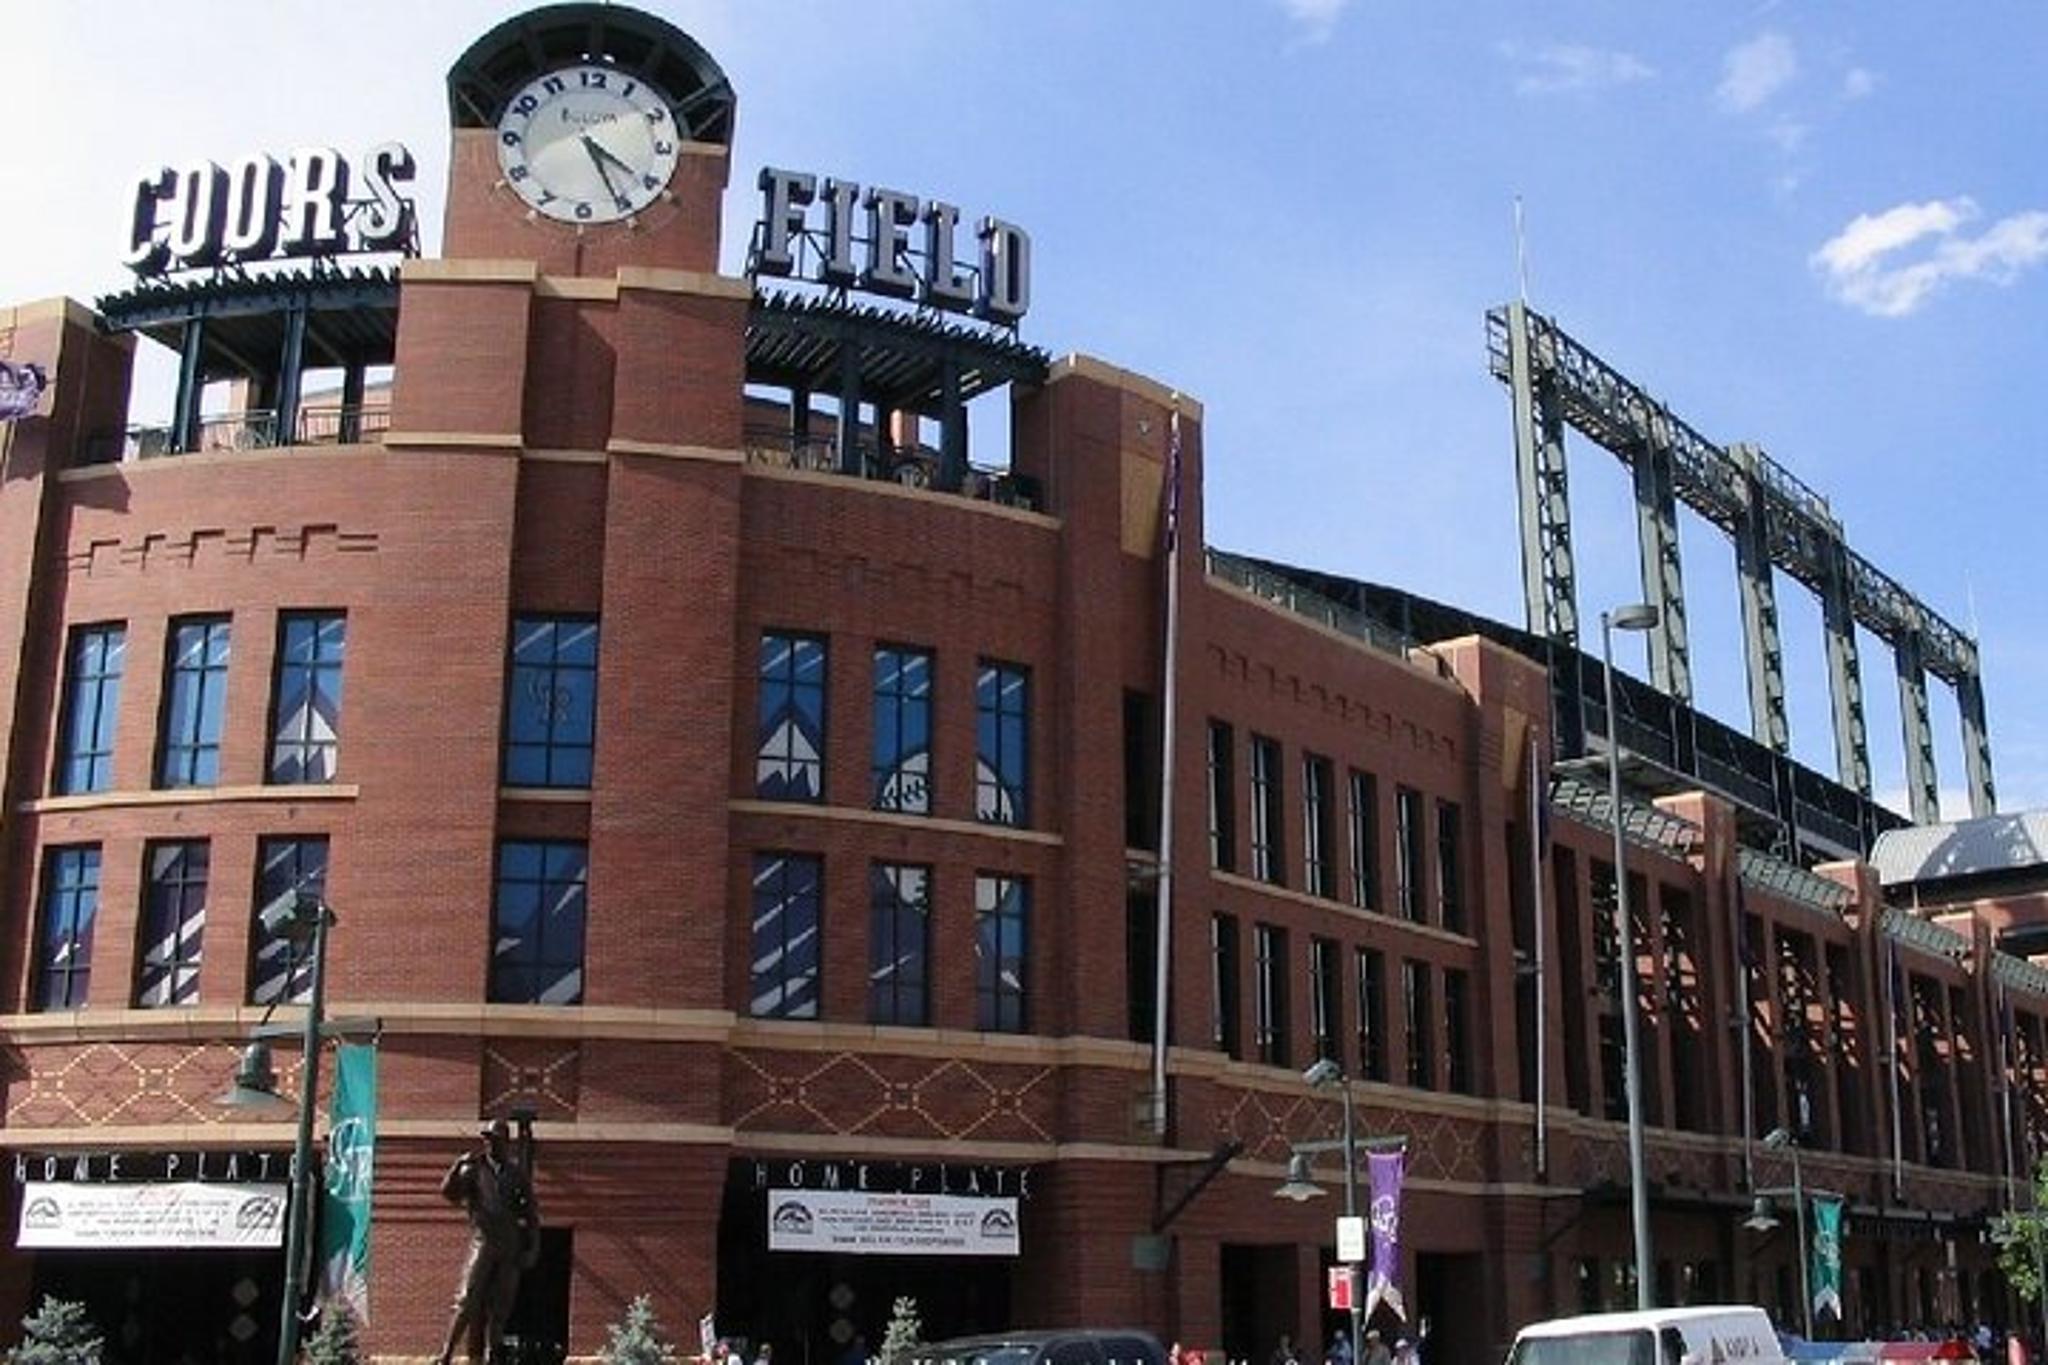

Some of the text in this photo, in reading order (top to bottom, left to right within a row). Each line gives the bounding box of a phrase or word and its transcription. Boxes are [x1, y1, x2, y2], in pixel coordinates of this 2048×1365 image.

[543, 76, 565, 94] 11
[580, 72, 607, 89] 12
[623, 82, 635, 97] 1
[512, 95, 539, 119] 10
[647, 107, 664, 125] 2
[502, 131, 521, 146] 9
[656, 141, 673, 156] 3
[509, 164, 528, 183] 8
[643, 173, 661, 191] 4
[537, 189, 558, 207] 7
[122, 140, 416, 276] COORS
[575, 202, 593, 220] 6
[756, 165, 1031, 328] FIELD
[756, 1162, 1029, 1195] HOME PLATE
